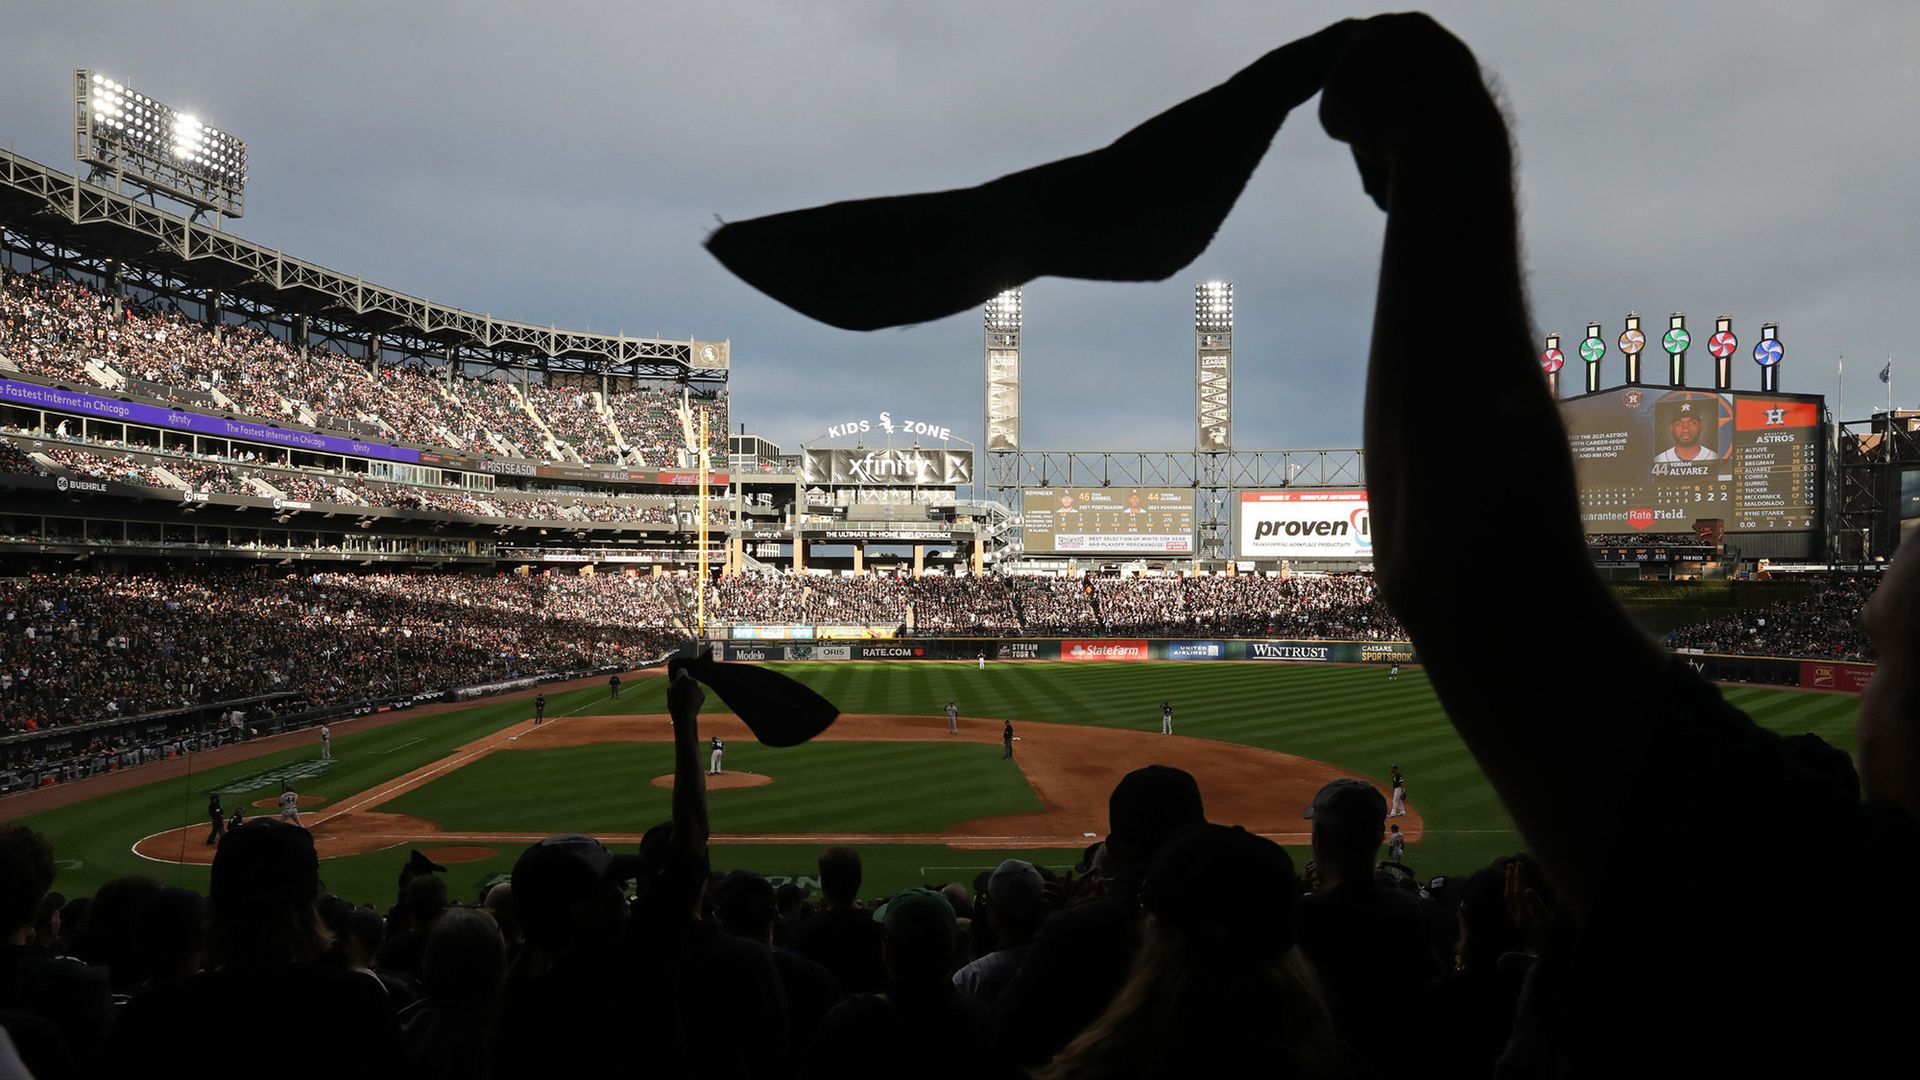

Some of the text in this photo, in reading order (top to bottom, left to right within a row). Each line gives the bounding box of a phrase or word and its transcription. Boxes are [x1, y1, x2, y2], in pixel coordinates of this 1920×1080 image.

[6, 384, 42, 400] Fastest
[43, 391, 81, 407] Internet
[83, 398, 92, 409] in
[93, 400, 130, 416] Chicago
[167, 414, 192, 427] xfinity
[1766, 409, 1784, 425] H
[828, 420, 870, 439] KIDS
[903, 420, 951, 440] ZONE
[226, 423, 326, 448] The Fastest Internet in Chicago
[1756, 435, 1795, 443] ASTROS
[353, 442, 370, 453] xfinity
[487, 460, 537, 476] POSTSEASON
[849, 453, 928, 483] xfinity
[1652, 463, 1708, 476] 44 ALVAREZ
[70, 480, 107, 491] BUEHRLE
[1079, 492, 1090, 500] 46
[1695, 493, 1701, 501] 3
[1708, 493, 1714, 501] 2
[1721, 492, 1728, 500] 2
[1582, 511, 1628, 520] uaranteed
[1630, 511, 1651, 520] Rate
[1255, 520, 1349, 540] proven
[736, 650, 765, 660] Modelo
[863, 648, 912, 657] RATE.COM
[1253, 644, 1328, 658] WINTRUST
[1362, 653, 1412, 662] SPORTSBOOK
[1816, 668, 1833, 676] CIBC
